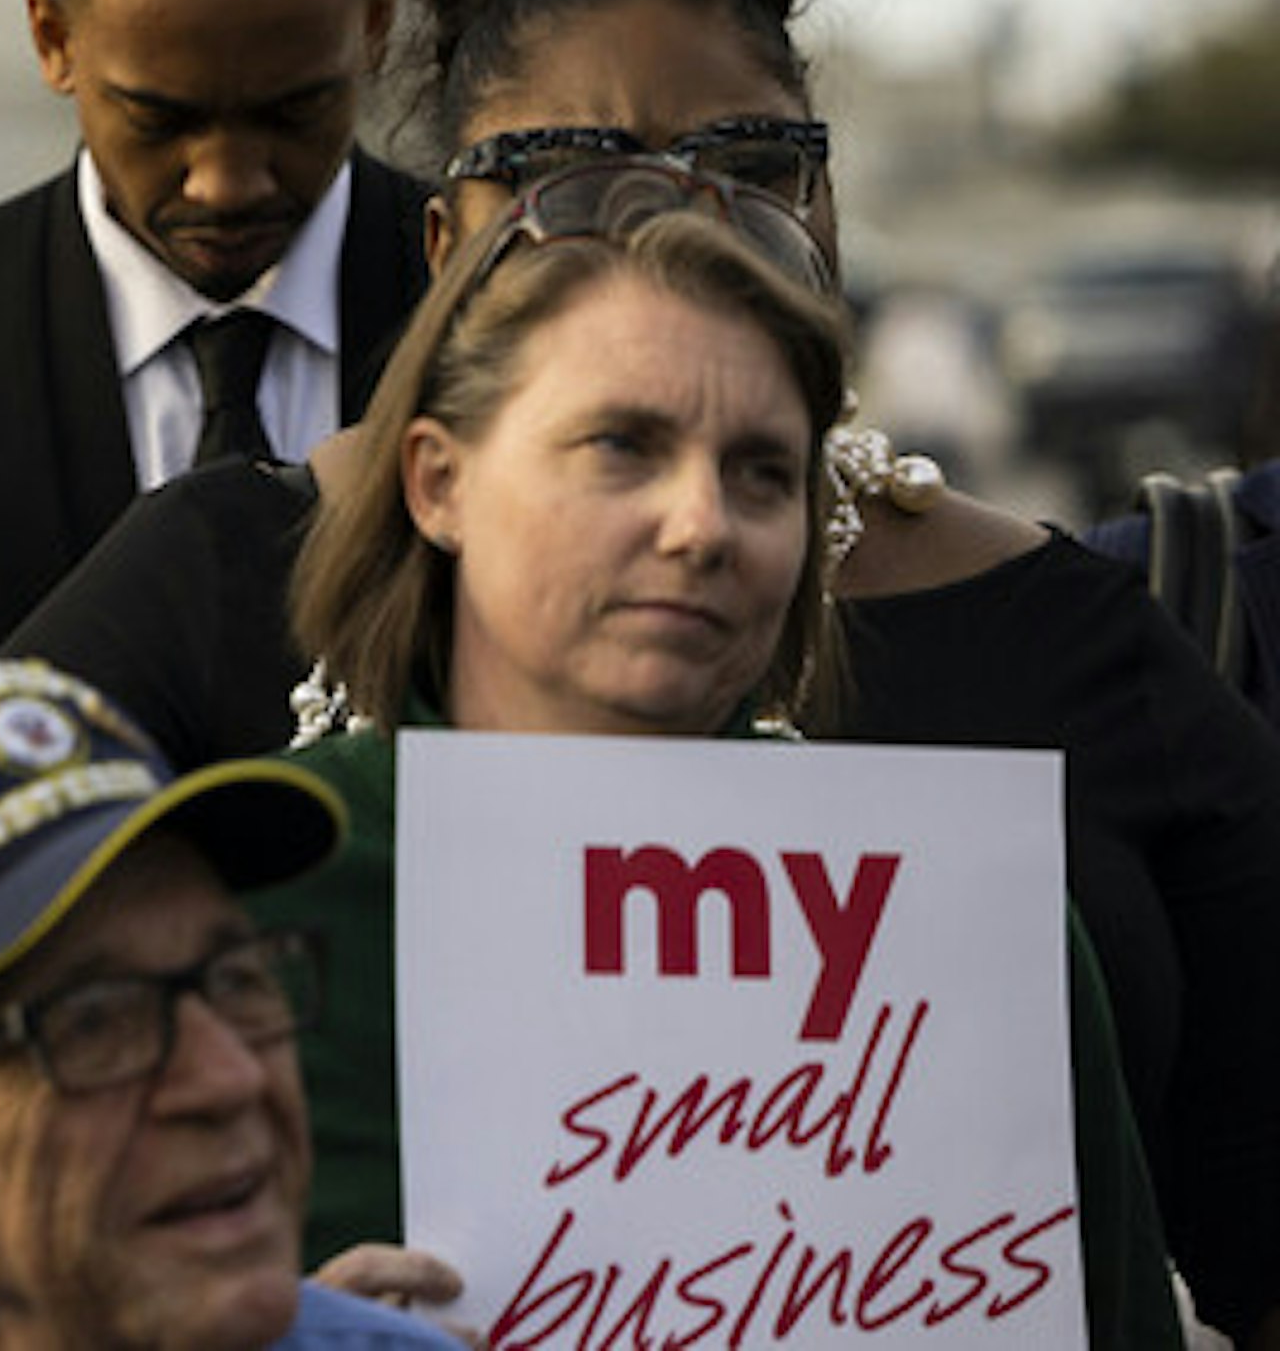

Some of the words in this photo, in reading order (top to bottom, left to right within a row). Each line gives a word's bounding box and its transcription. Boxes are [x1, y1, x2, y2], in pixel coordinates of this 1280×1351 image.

[583, 843, 903, 1044] my
[544, 999, 930, 1188] small
[485, 1201, 1078, 1351] business
